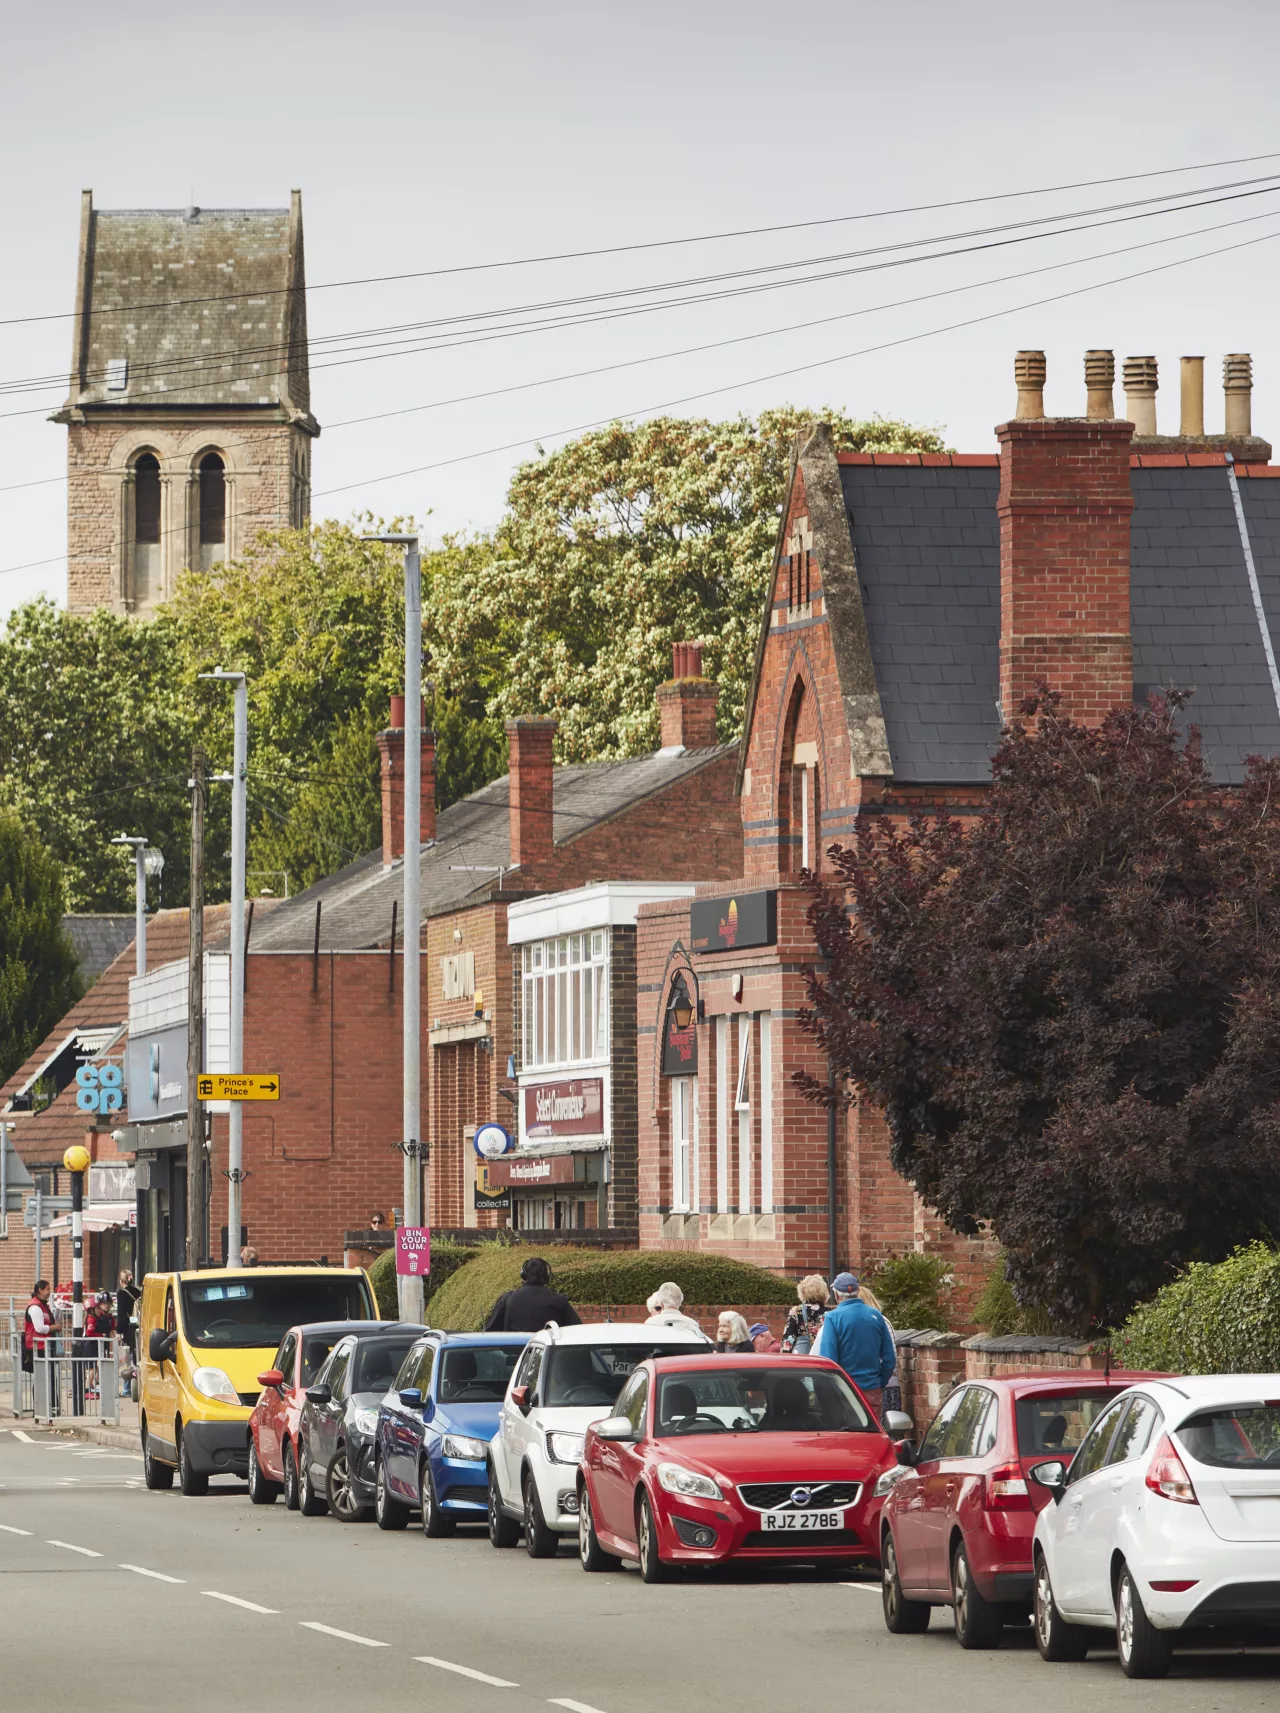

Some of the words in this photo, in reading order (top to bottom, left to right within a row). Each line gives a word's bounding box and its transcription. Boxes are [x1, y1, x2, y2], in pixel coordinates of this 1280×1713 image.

[218, 1078, 254, 1087] Prince's
[224, 1087, 249, 1096] Place
[405, 1229, 422, 1237] BIN
[400, 1236, 428, 1244] YOUR
[401, 1243, 426, 1251] GUM.
[767, 1515, 796, 1529] RJZ
[800, 1513, 838, 1528] 2786
